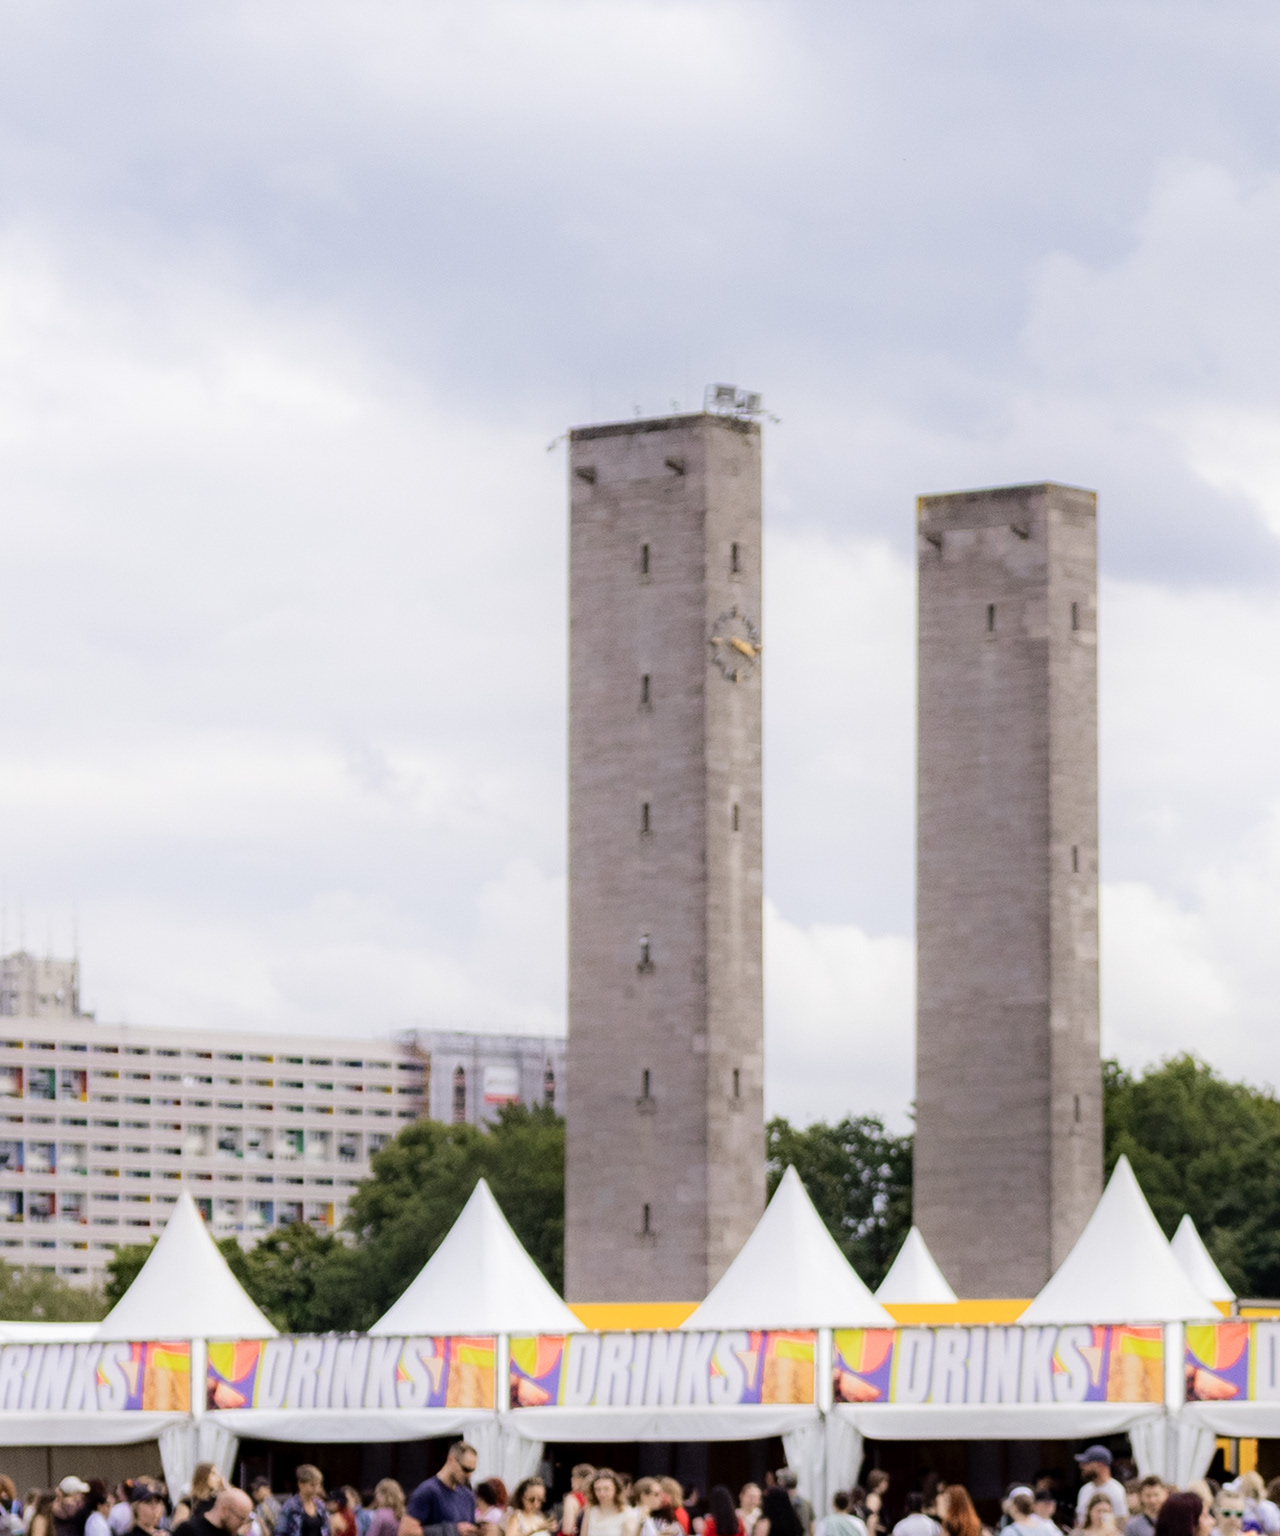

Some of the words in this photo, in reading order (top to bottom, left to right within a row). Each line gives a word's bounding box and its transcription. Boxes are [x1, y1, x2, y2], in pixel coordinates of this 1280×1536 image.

[258, 1337, 436, 1409] DRINKS
[564, 1331, 749, 1405] DRINKS
[896, 1326, 1094, 1402] DRINKS
